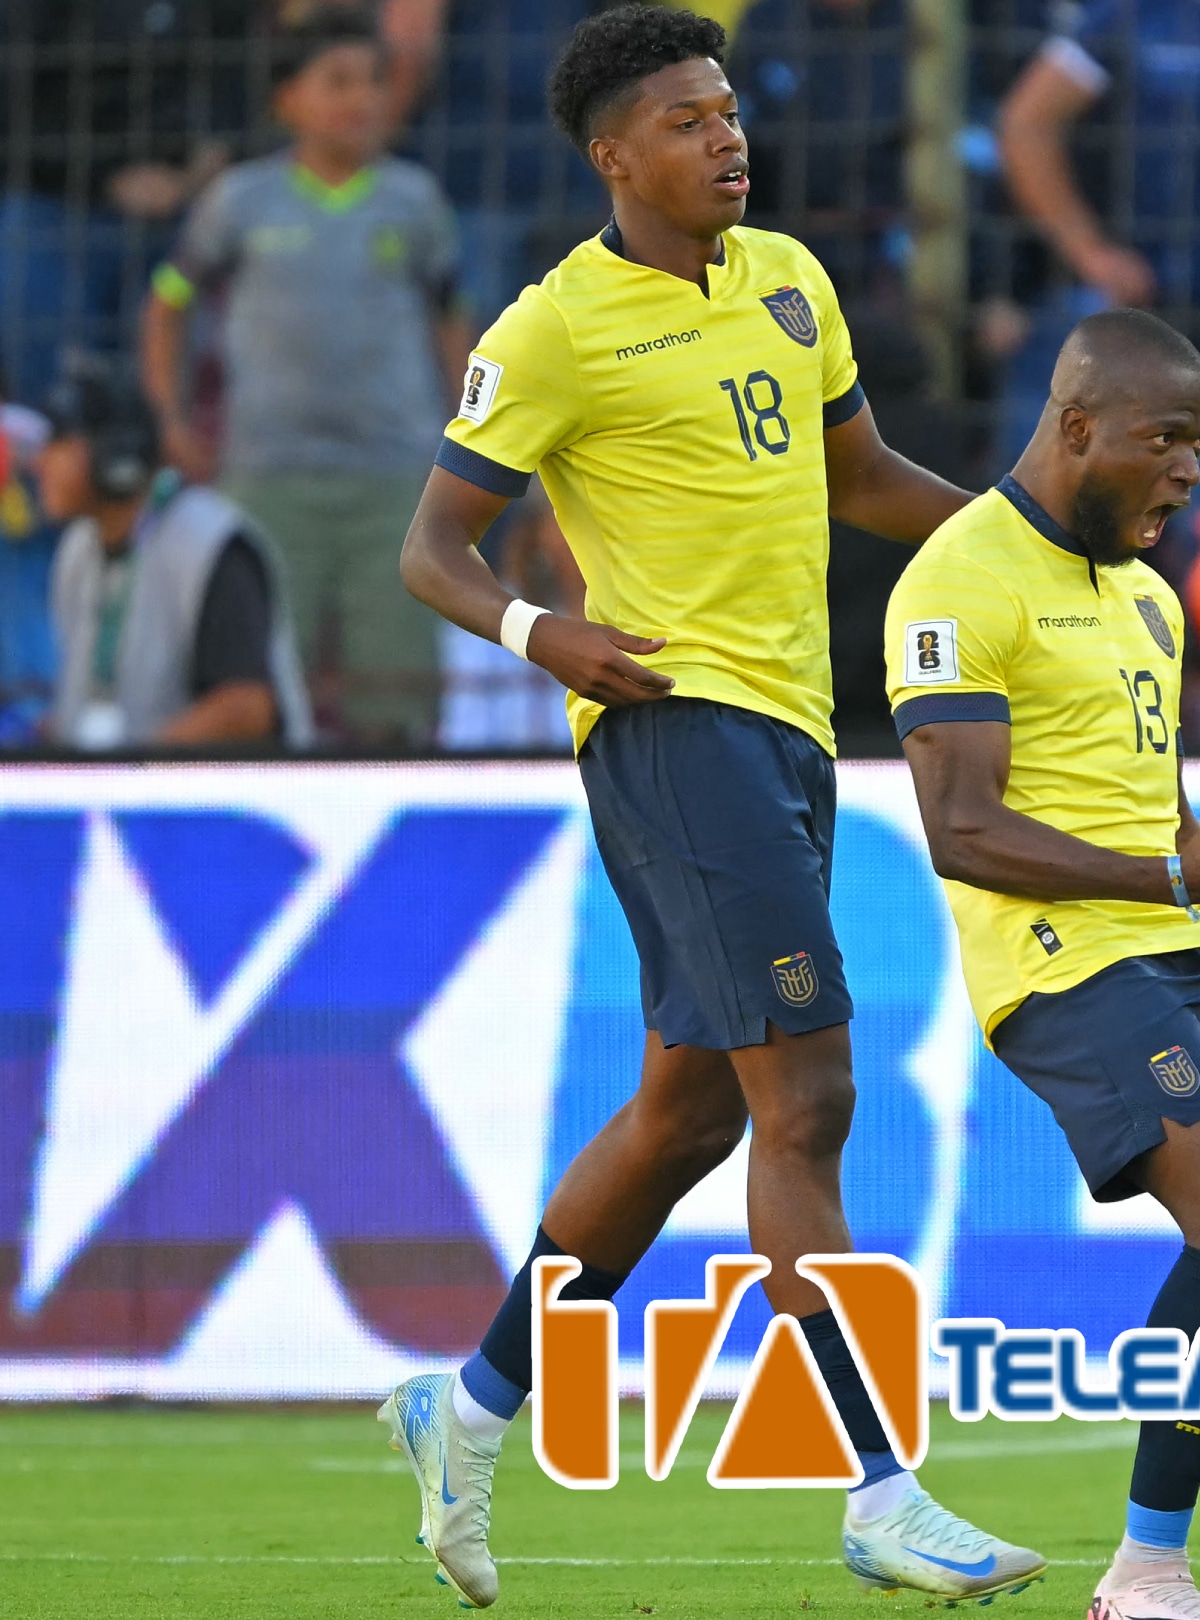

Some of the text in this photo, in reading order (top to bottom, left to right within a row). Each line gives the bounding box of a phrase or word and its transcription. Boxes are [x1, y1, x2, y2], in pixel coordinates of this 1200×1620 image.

[615, 328, 703, 361] marathon
[718, 369, 791, 462] 18
[1037, 614, 1102, 630] marathon
[1118, 668, 1169, 755] 13
